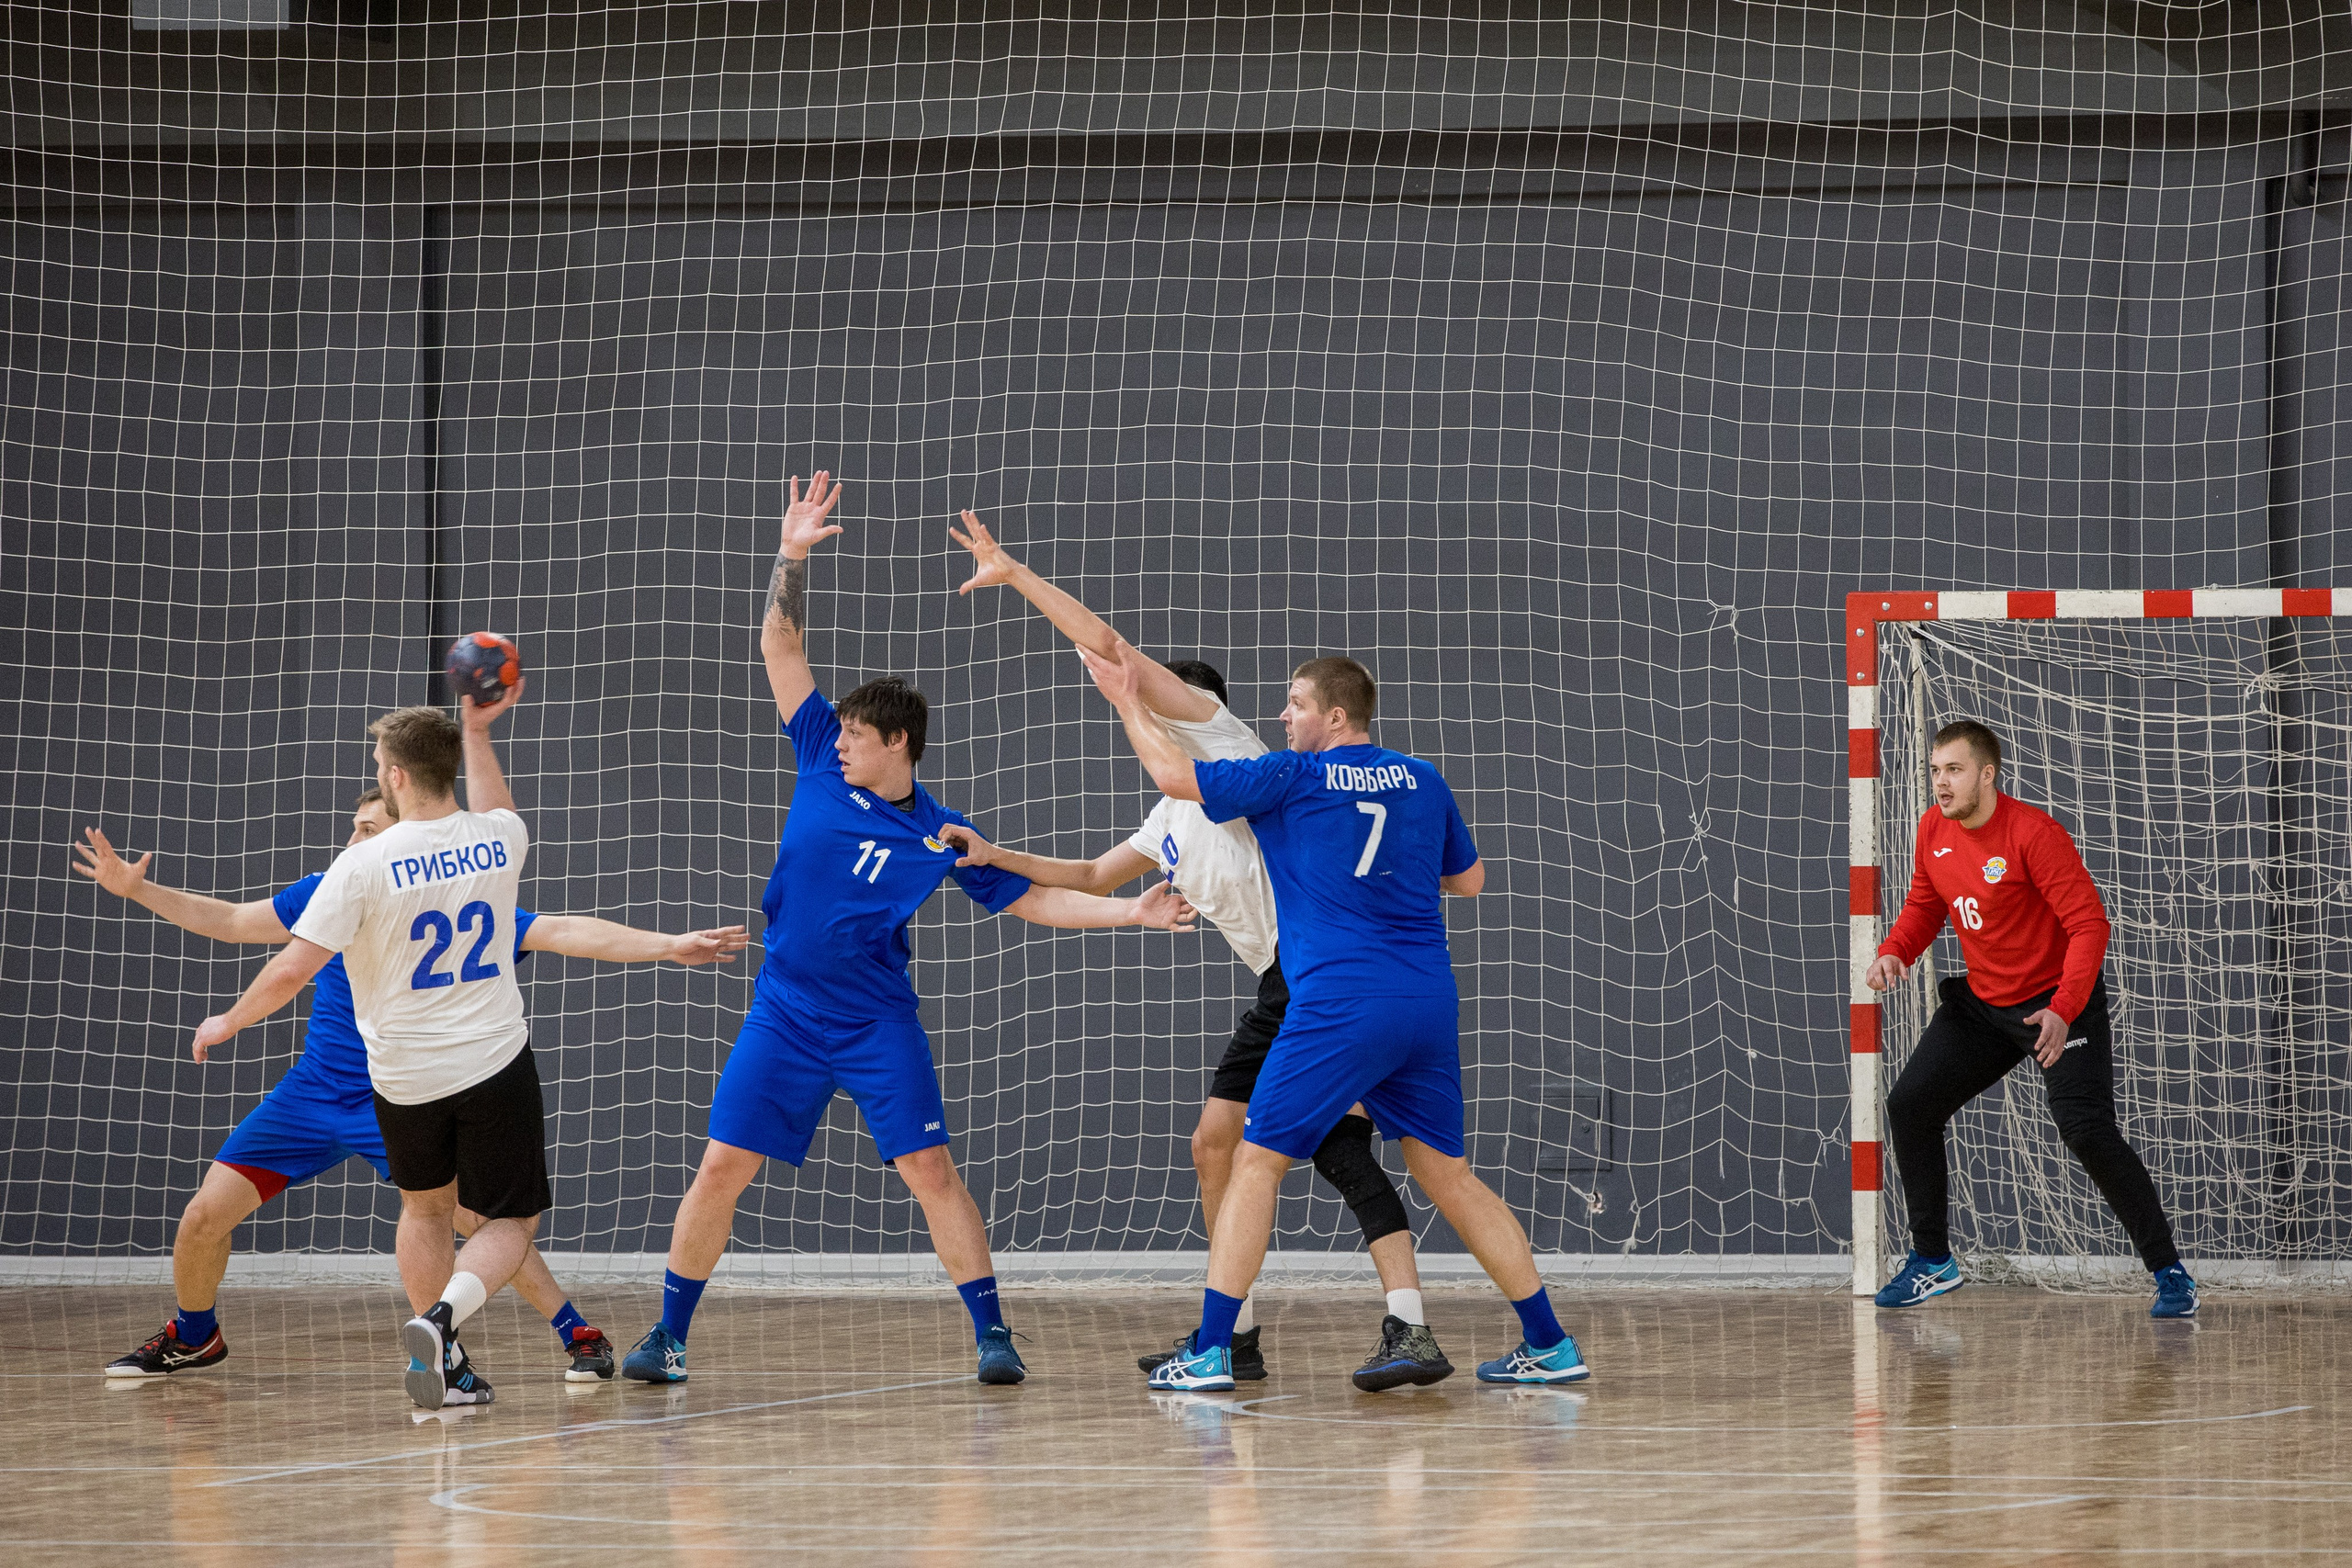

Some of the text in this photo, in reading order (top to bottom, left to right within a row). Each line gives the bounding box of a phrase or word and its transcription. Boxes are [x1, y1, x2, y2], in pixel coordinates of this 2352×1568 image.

[1325, 762, 1418, 793] КОВБАРЬ
[849, 791, 871, 810] JAKO
[1353, 800, 1387, 878] 7
[390, 840, 507, 888] ГРИБКОВ
[852, 840, 891, 885] 11
[1952, 896, 1984, 931] 16
[410, 900, 501, 991] 22
